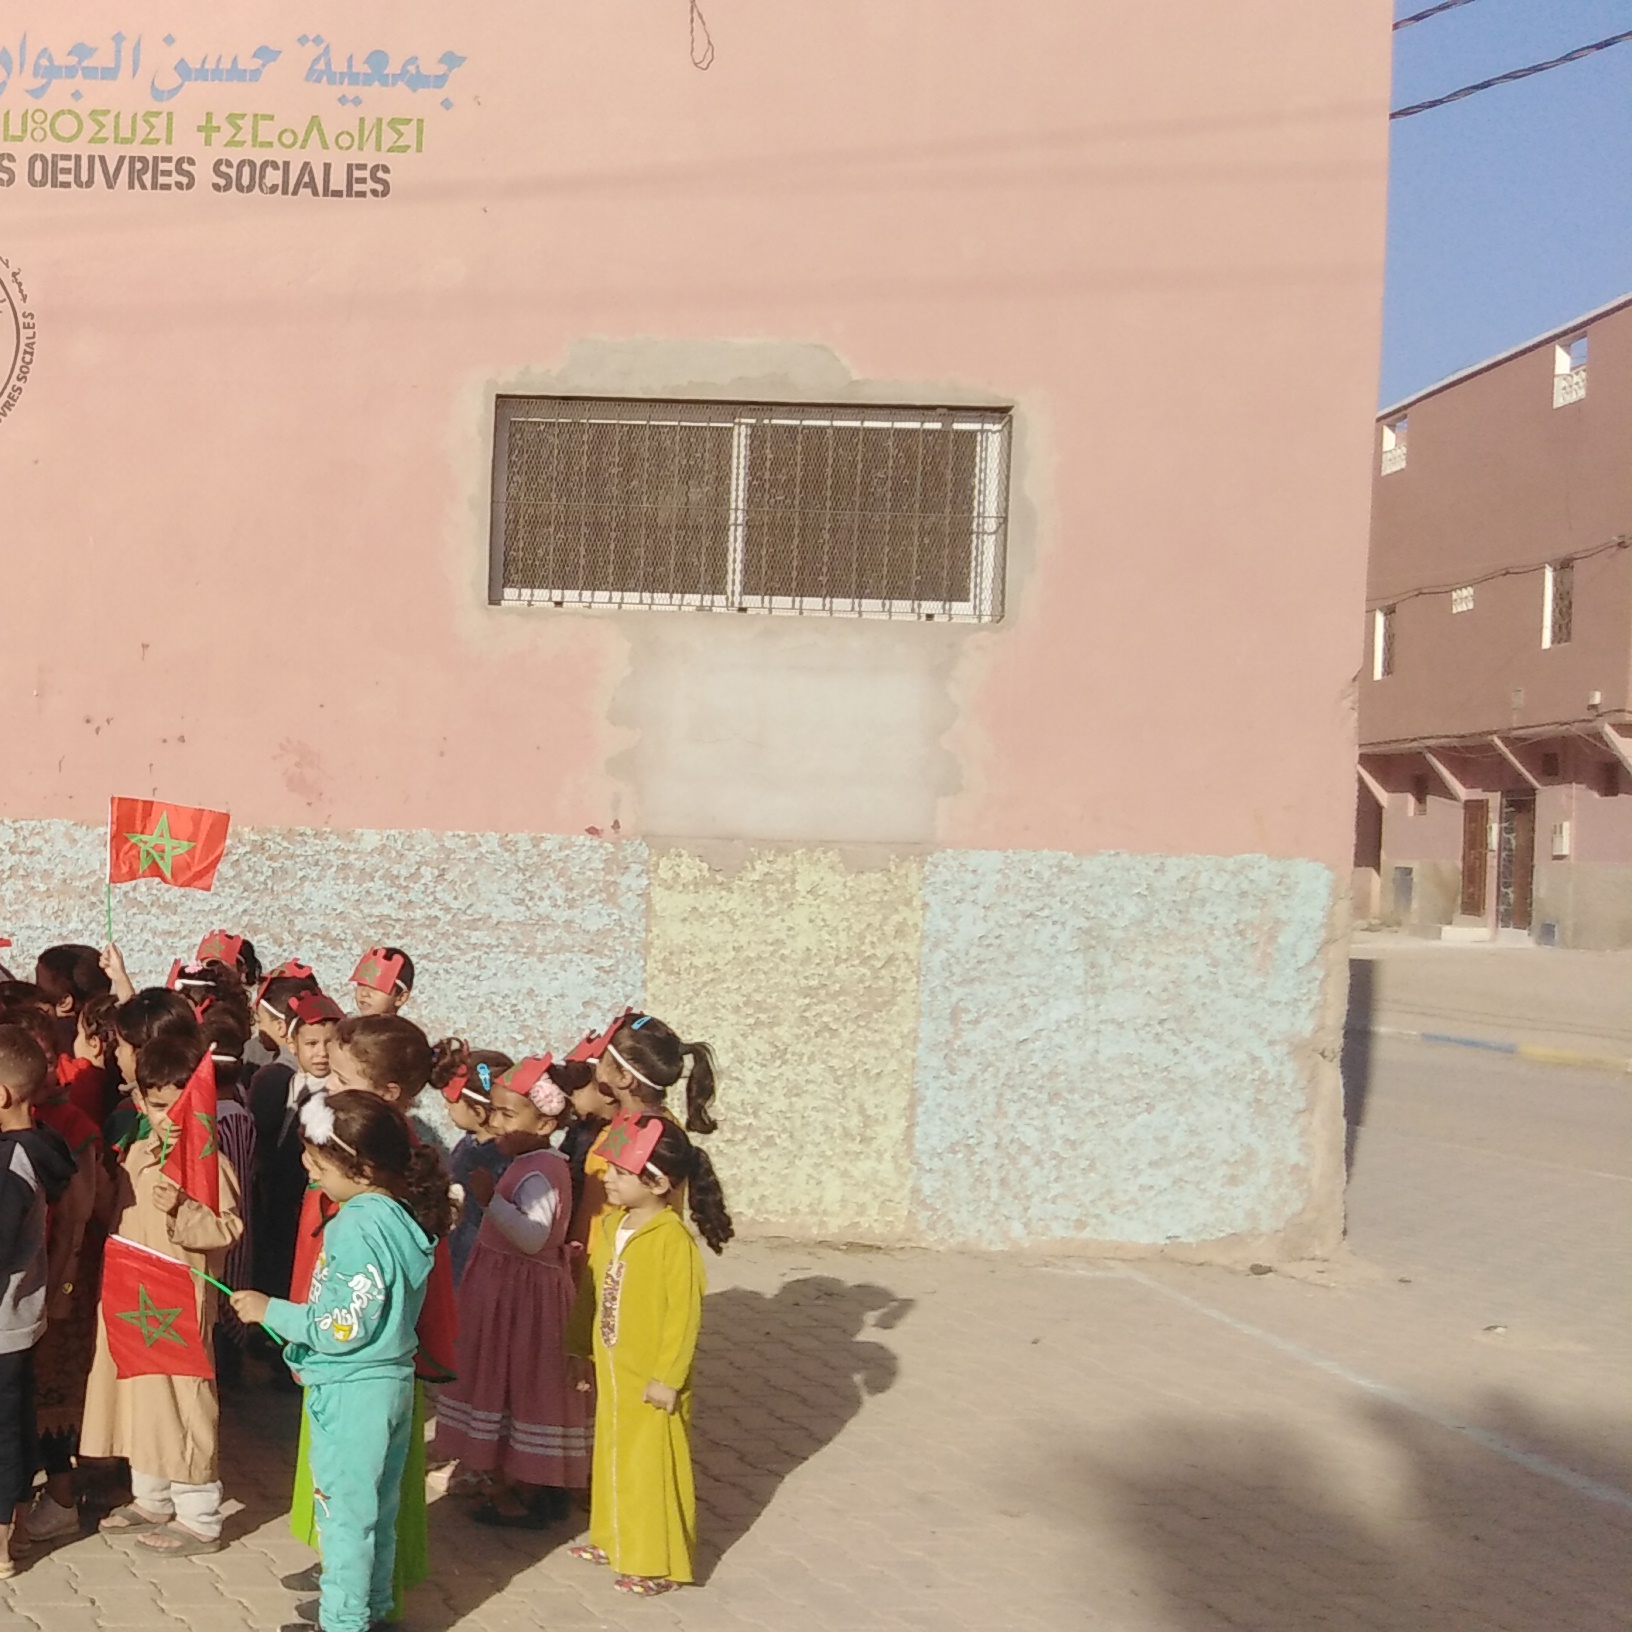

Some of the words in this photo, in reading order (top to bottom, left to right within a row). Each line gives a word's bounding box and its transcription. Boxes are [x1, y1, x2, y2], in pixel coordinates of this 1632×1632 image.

[150, 33, 282, 102] حسن
[297, 33, 467, 110] جمعية
[27, 153, 197, 191] OEUVRES
[211, 157, 391, 198] SOCIALES
[11, 267, 28, 304] جمعية
[16, 311, 36, 384] SOCIALES
